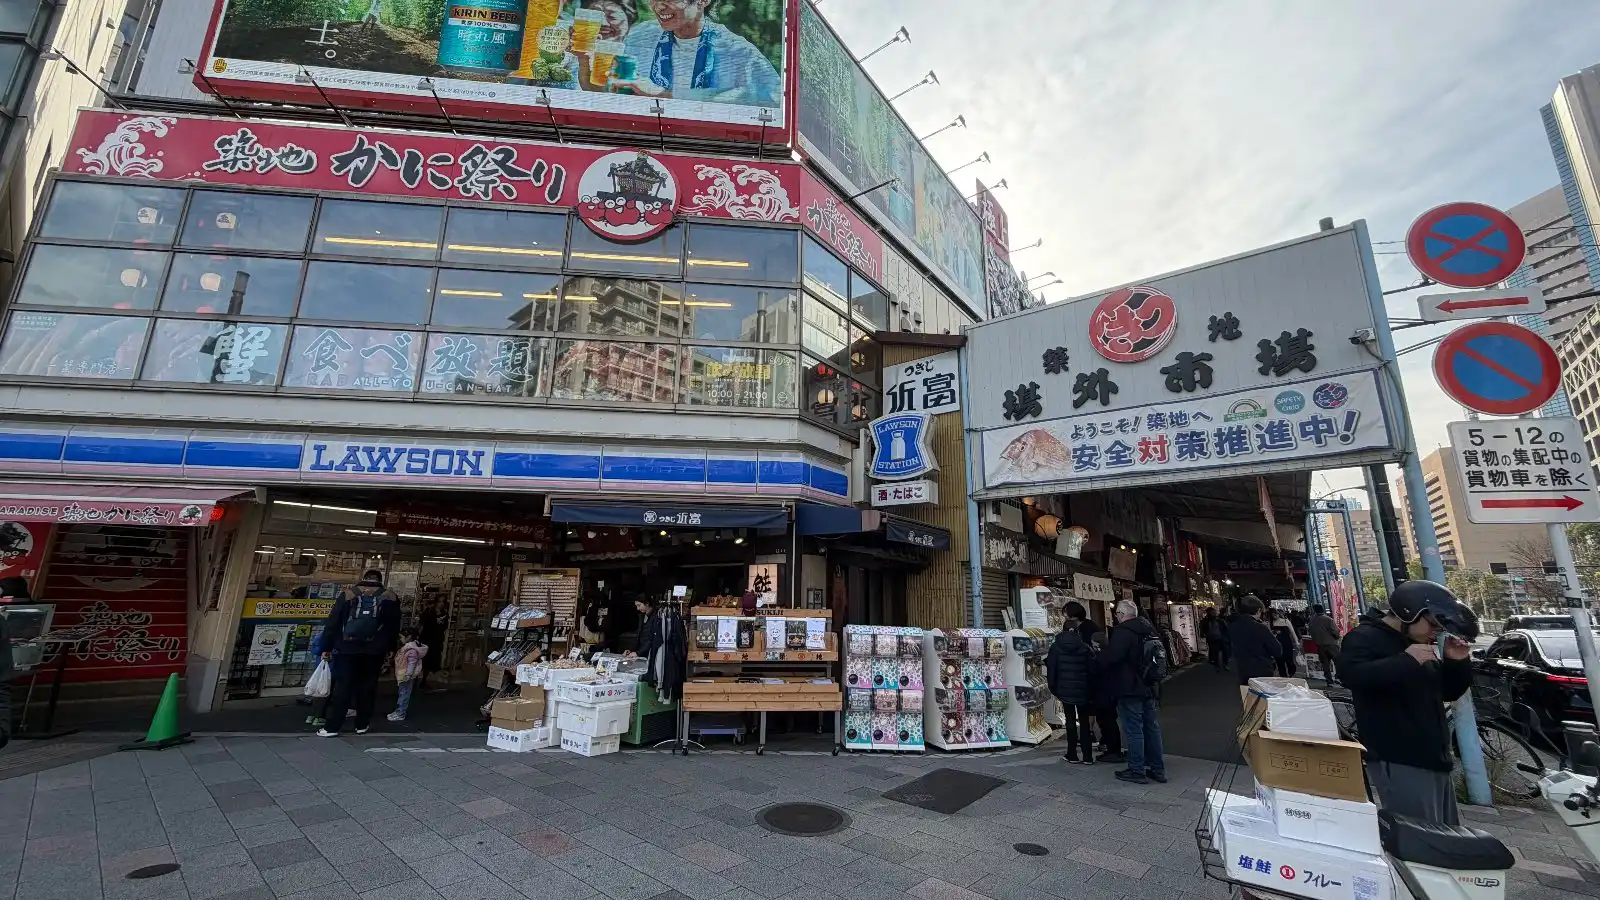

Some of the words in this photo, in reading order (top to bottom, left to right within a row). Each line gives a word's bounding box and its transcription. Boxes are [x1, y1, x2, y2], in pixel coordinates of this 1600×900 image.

[453, 8, 488, 19] KIRIN
[490, 10, 518, 22] BEER
[304, 328, 535, 383] 食べ放題
[904, 360, 935, 376] つきじ
[707, 390, 733, 398] 10:00
[743, 391, 768, 400] 21:00
[878, 420, 918, 434] LAWSON
[1146, 409, 1213, 431] 築地へ
[1071, 408, 1361, 472] 安全対策推進中!
[310, 444, 485, 476] LAWSON
[878, 456, 920, 470] STATION
[1462, 447, 1582, 467] 貨物の集配中の
[1465, 467, 1588, 488] 貨物車を除く
[878, 486, 923, 501] 酒・たばこ
[755, 608, 784, 616] SUKIJI
[1237, 854, 1272, 875] 塩鮭
[1303, 869, 1342, 888] フィレー
